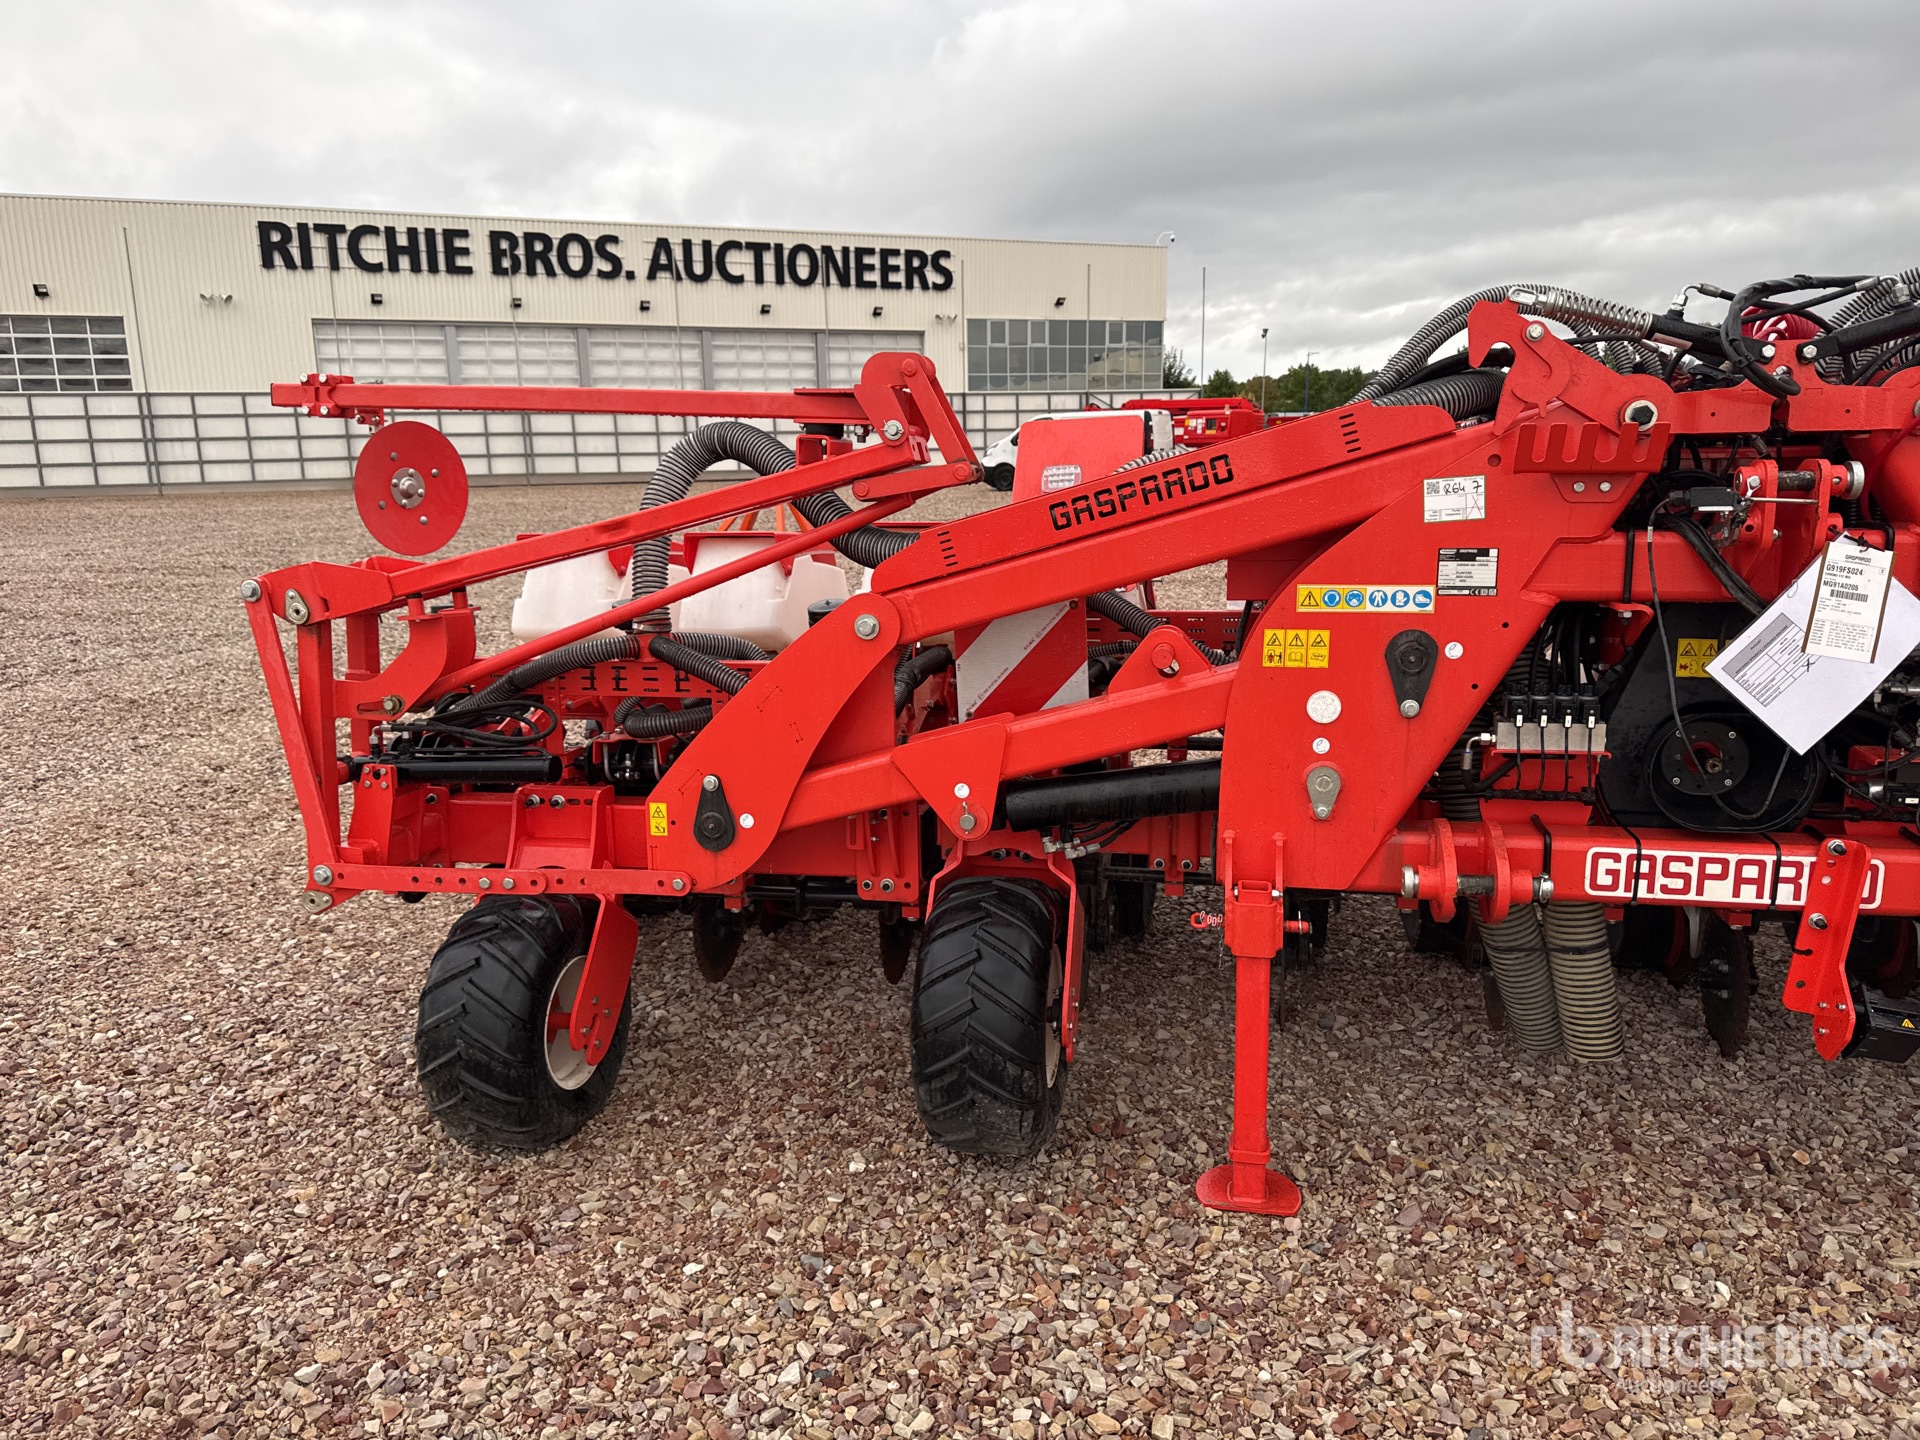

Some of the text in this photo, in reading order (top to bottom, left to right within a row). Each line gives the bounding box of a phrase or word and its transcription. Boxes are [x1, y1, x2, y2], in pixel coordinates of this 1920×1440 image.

[257, 220, 953, 291] RITCHIE BROS. AUCTIONEERS
[1049, 454, 1235, 532] GASPARDO
[1823, 579, 1859, 592] MG91A0205
[1826, 563, 1863, 576] G919FS024
[1589, 852, 1880, 905] GASPAR
